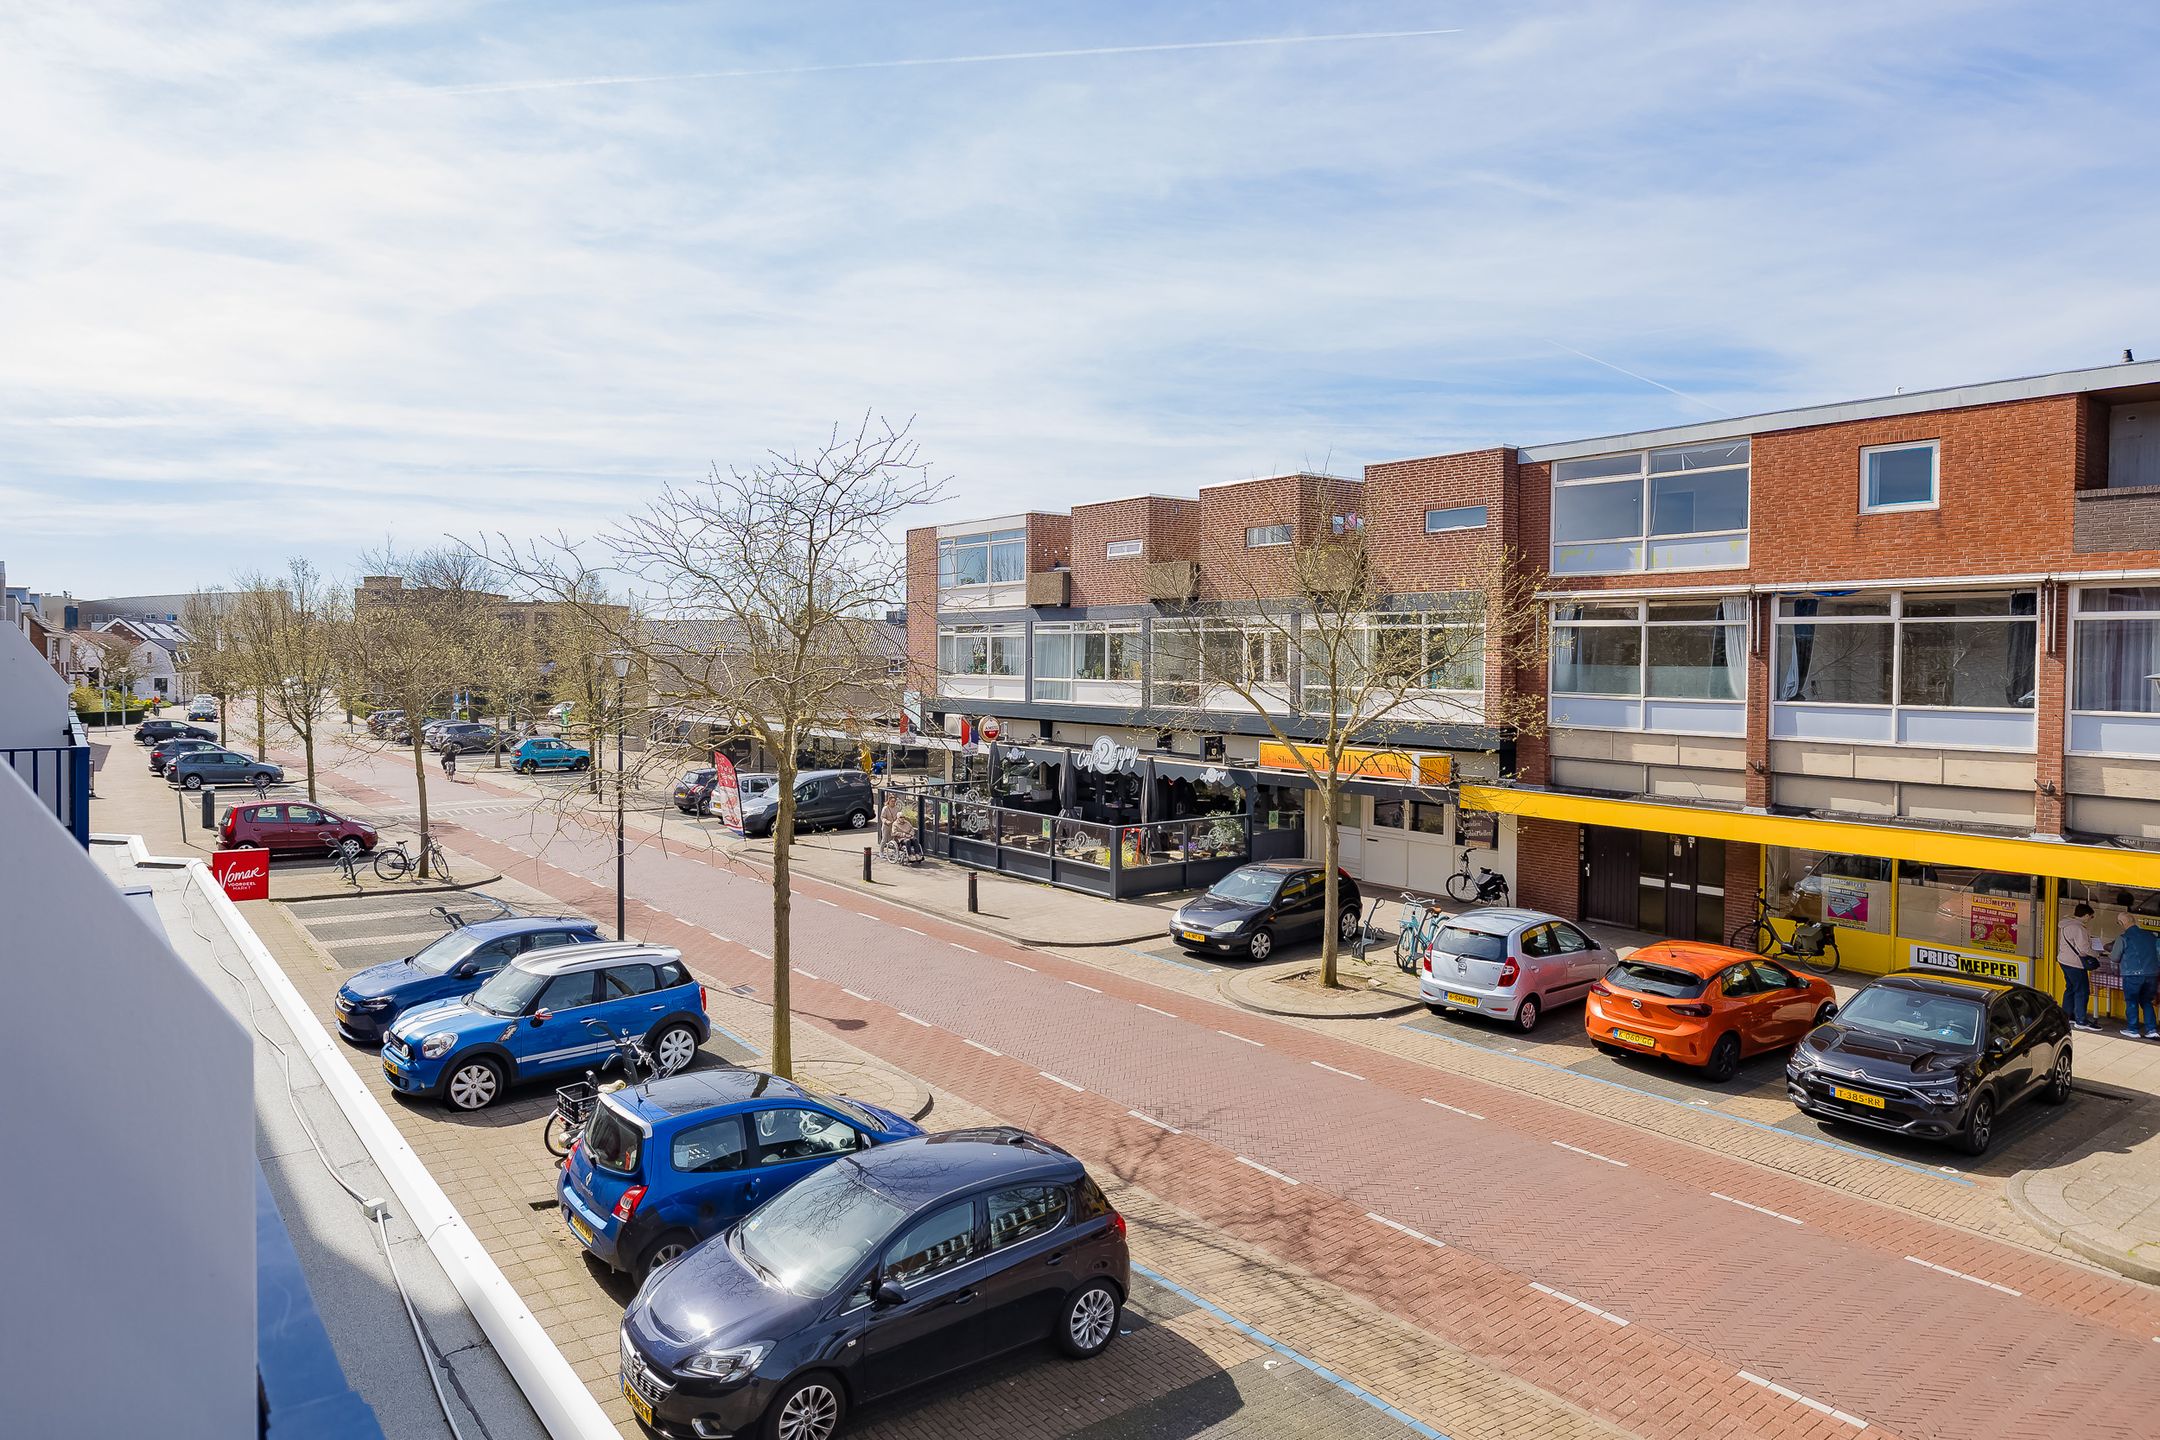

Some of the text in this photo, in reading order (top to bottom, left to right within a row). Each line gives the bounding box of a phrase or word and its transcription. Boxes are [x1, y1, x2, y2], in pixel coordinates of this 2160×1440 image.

[218, 861, 266, 889] Vomar
[1448, 993, 1476, 1005] 6-SHJ-64
[1838, 1089, 1881, 1107] T-385-RR
